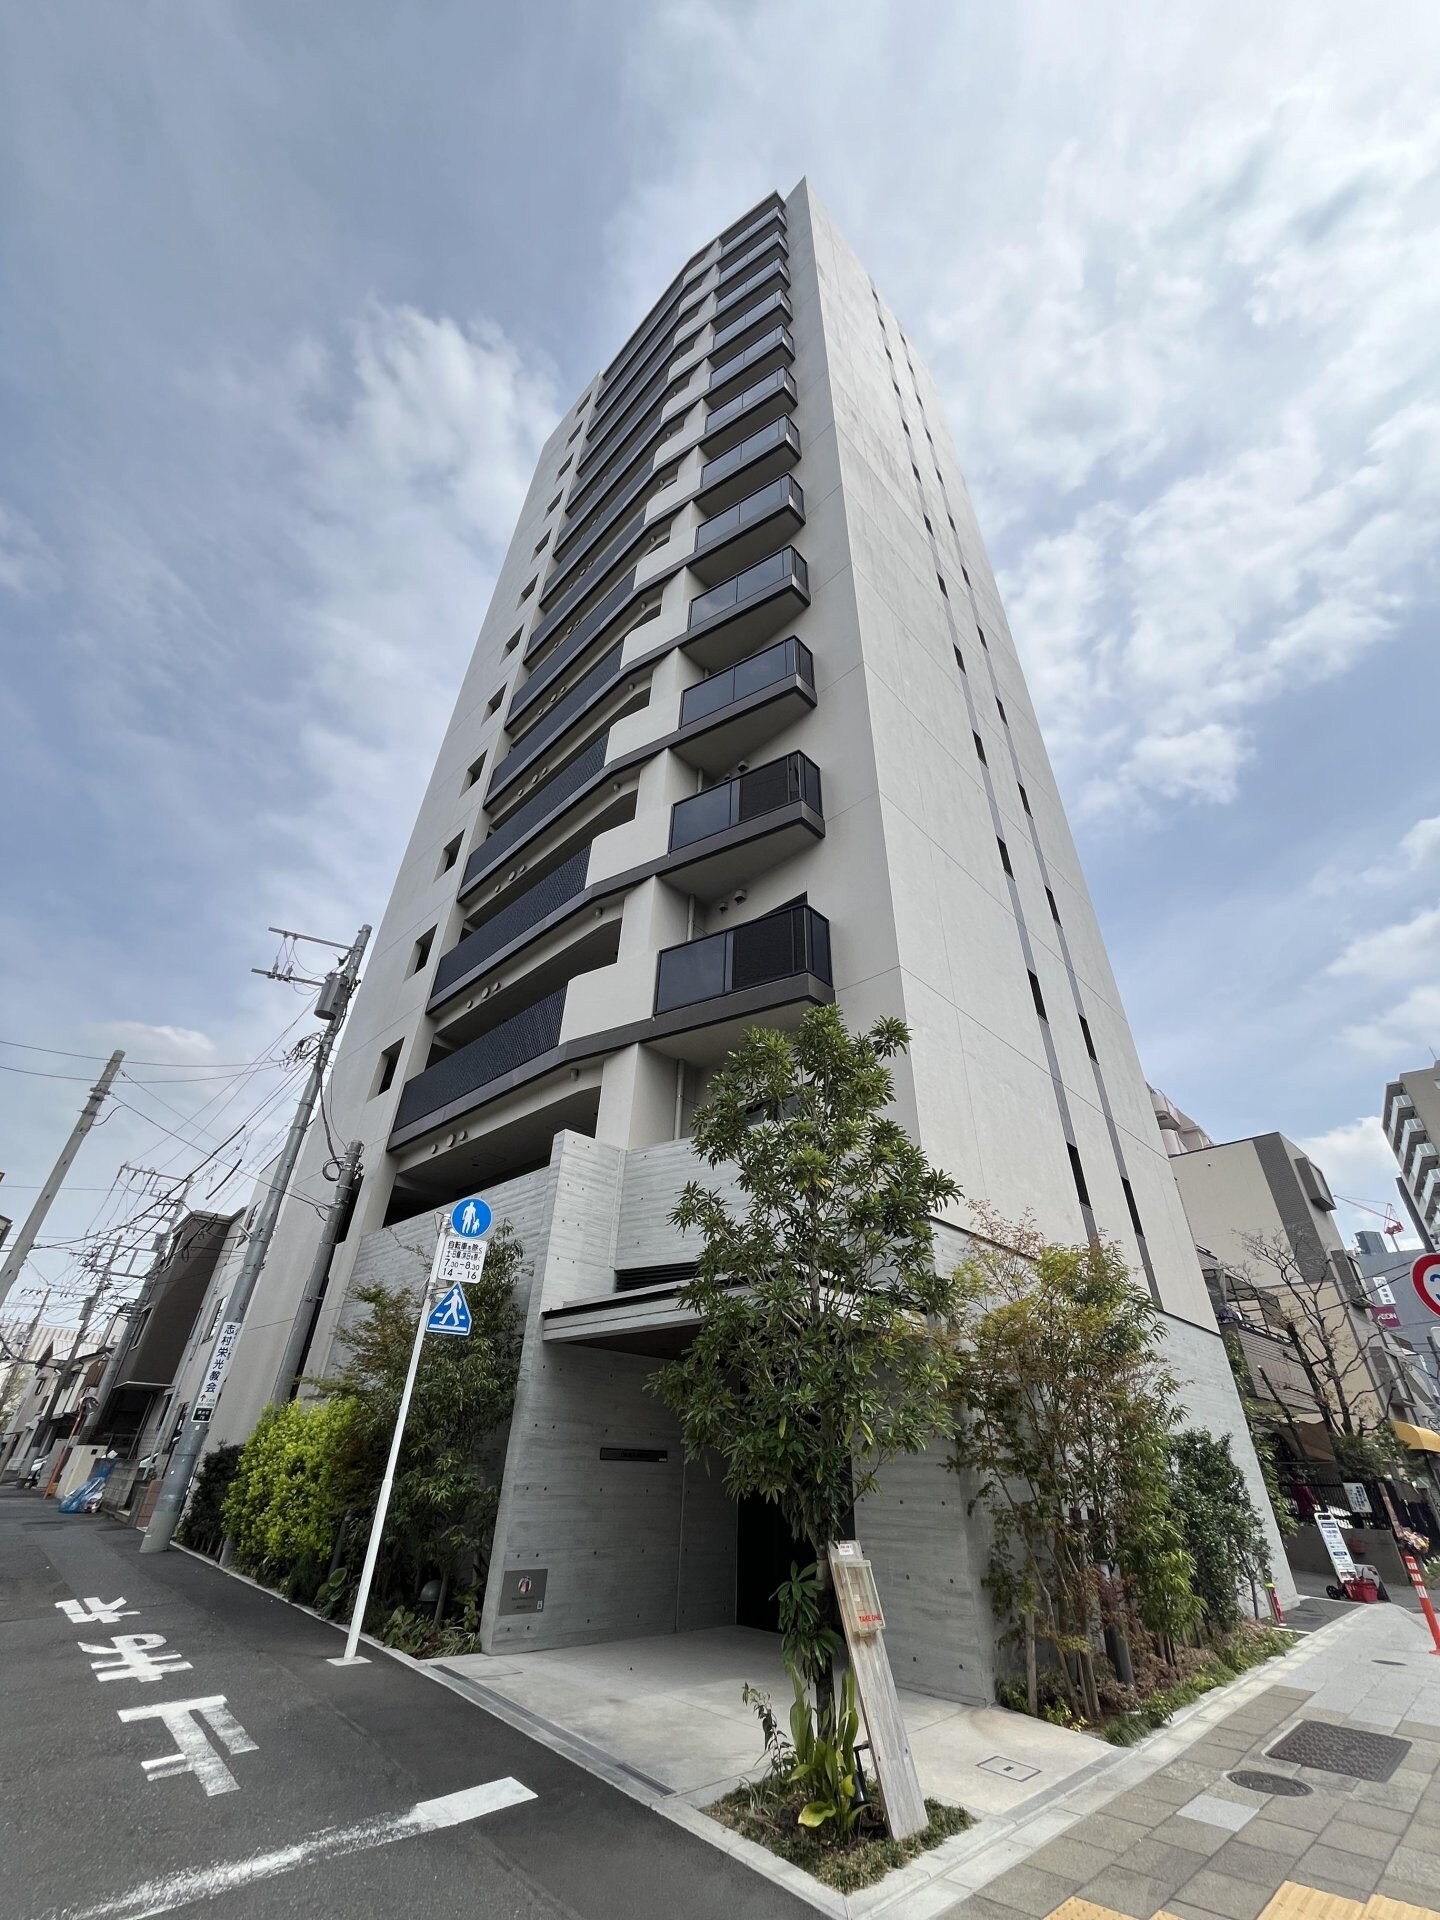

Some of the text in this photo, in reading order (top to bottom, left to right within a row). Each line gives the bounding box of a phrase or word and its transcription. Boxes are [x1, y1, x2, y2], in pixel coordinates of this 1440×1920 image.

[448, 1241, 483, 1253] 自転車を除く
[205, 1324, 236, 1393] 志村栄光教会
